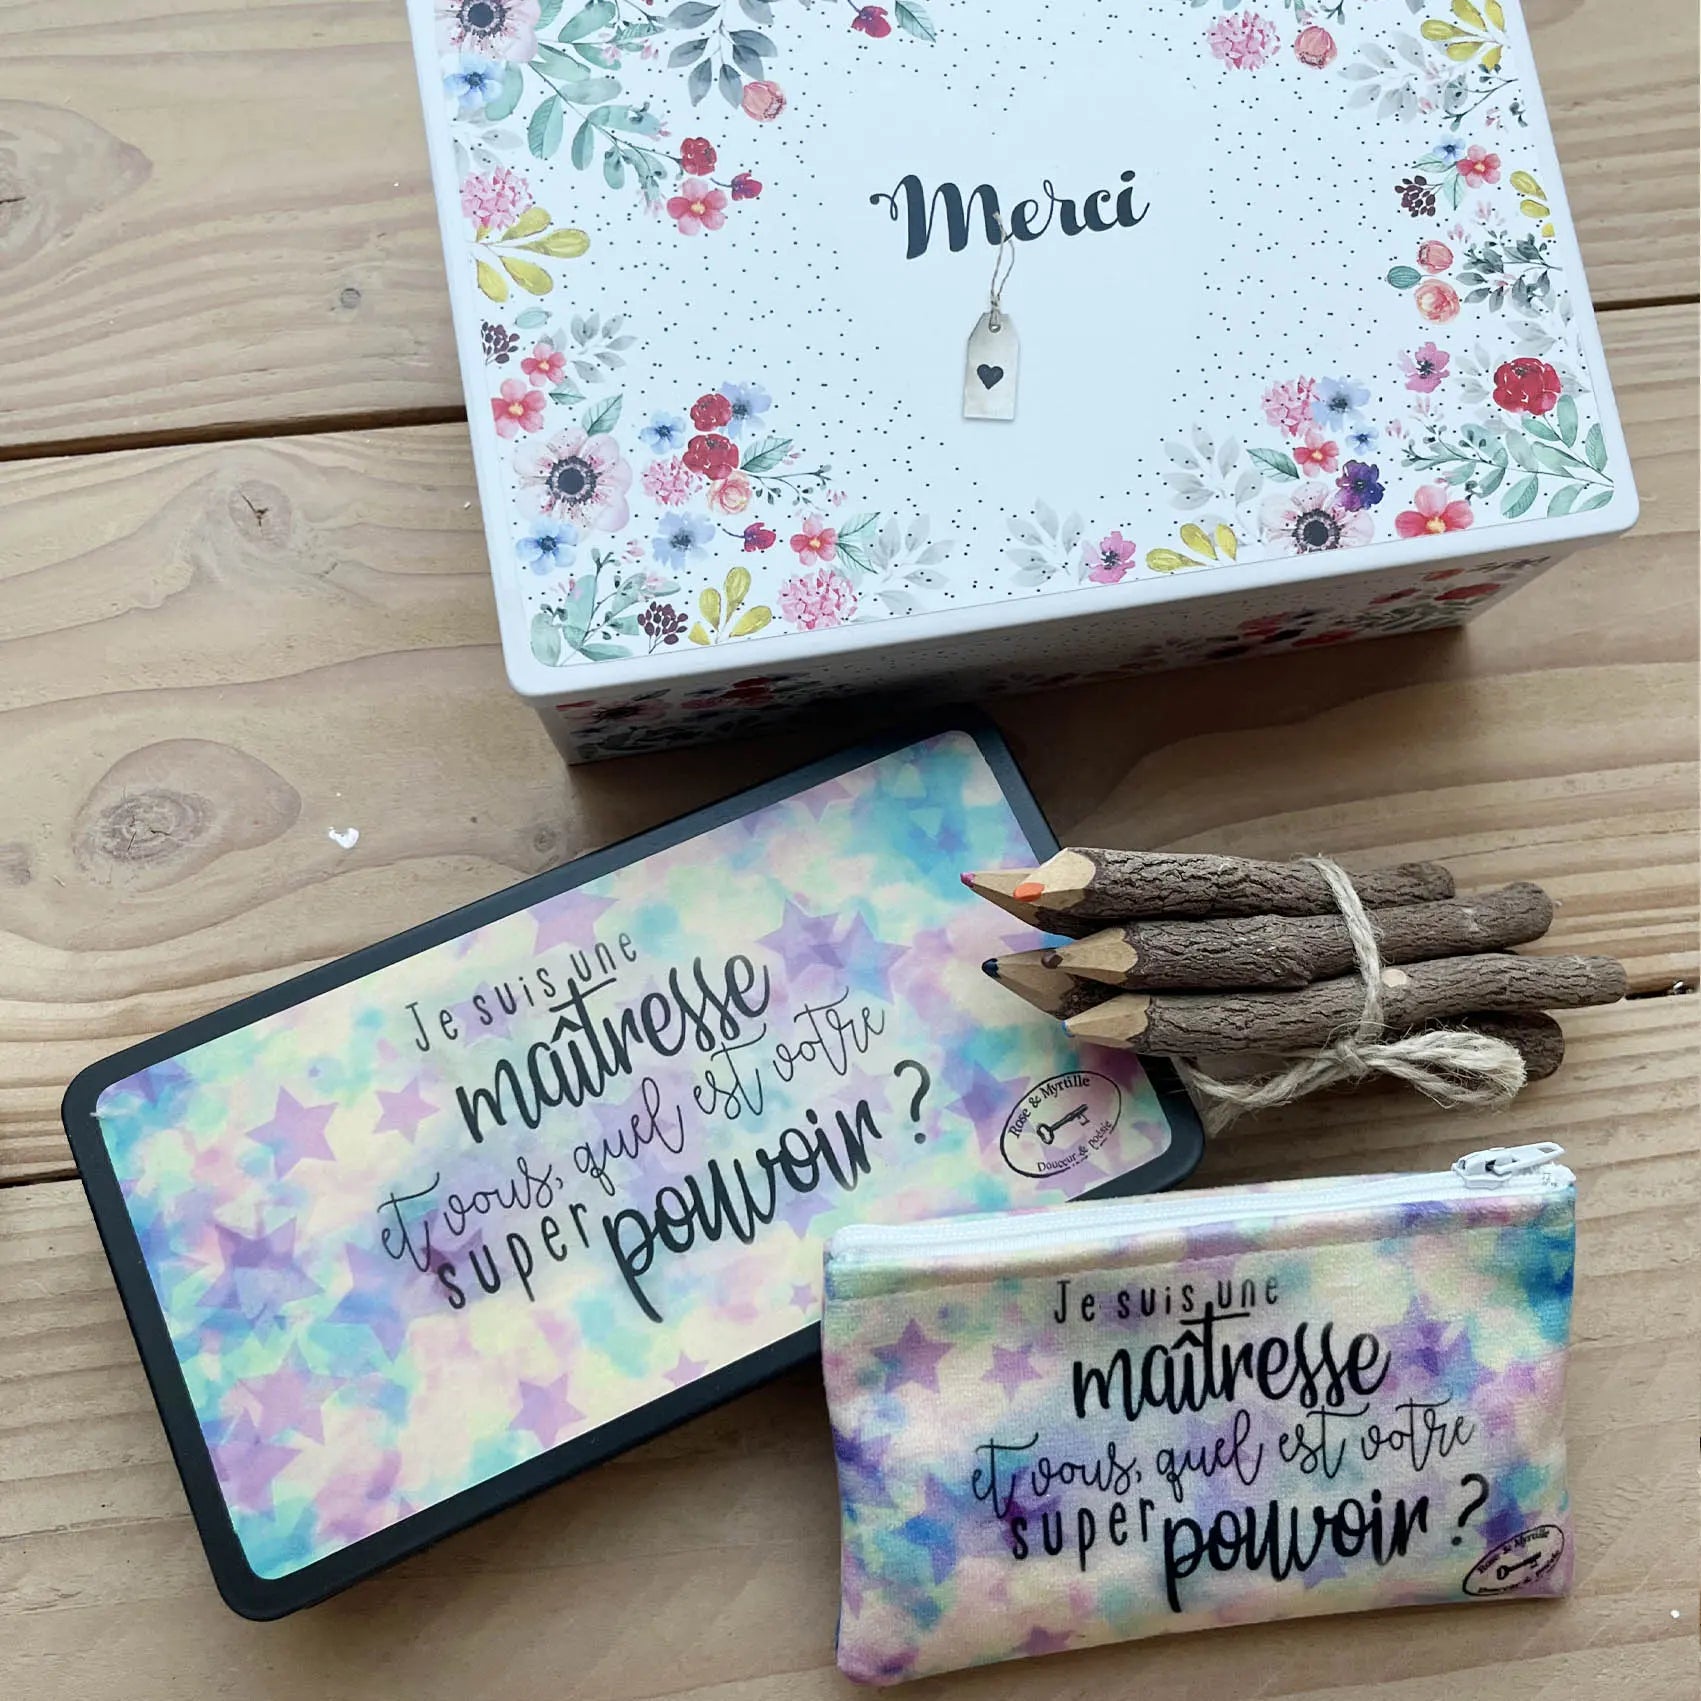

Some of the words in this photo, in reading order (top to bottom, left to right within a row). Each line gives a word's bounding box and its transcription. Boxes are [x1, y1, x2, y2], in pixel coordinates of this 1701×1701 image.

[869, 170, 1150, 259] Merci
[405, 1002, 458, 1052] Je
[473, 969, 556, 1015] suis
[569, 932, 638, 983] une
[456, 953, 771, 1144] maîtresse
[377, 1173, 441, 1274] et
[443, 1156, 563, 1237] vous,
[573, 1077, 685, 1196] quel
[693, 1023, 767, 1119] est
[773, 986, 885, 1083] votre
[1007, 1108, 1031, 1139] Rose
[1028, 1095, 1041, 1108] &
[1040, 1075, 1090, 1099] Myrtille
[1037, 1153, 1076, 1172] Douceur
[437, 1201, 588, 1309] super
[603, 1100, 882, 1324] pouvoir
[894, 1058, 931, 1145] ?
[1053, 1279, 1095, 1324] Je
[1117, 1283, 1193, 1319] suis
[1217, 1274, 1279, 1307] une
[1073, 1301, 1391, 1421] maîtresse
[971, 1432, 1039, 1520] et
[1031, 1440, 1142, 1495] vous,
[1156, 1408, 1263, 1502] quel
[1279, 1402, 1370, 1478] est
[1360, 1392, 1475, 1471] votre
[1010, 1497, 1154, 1572] super
[1162, 1489, 1429, 1613] pouvoir
[1450, 1473, 1490, 1546] ?
